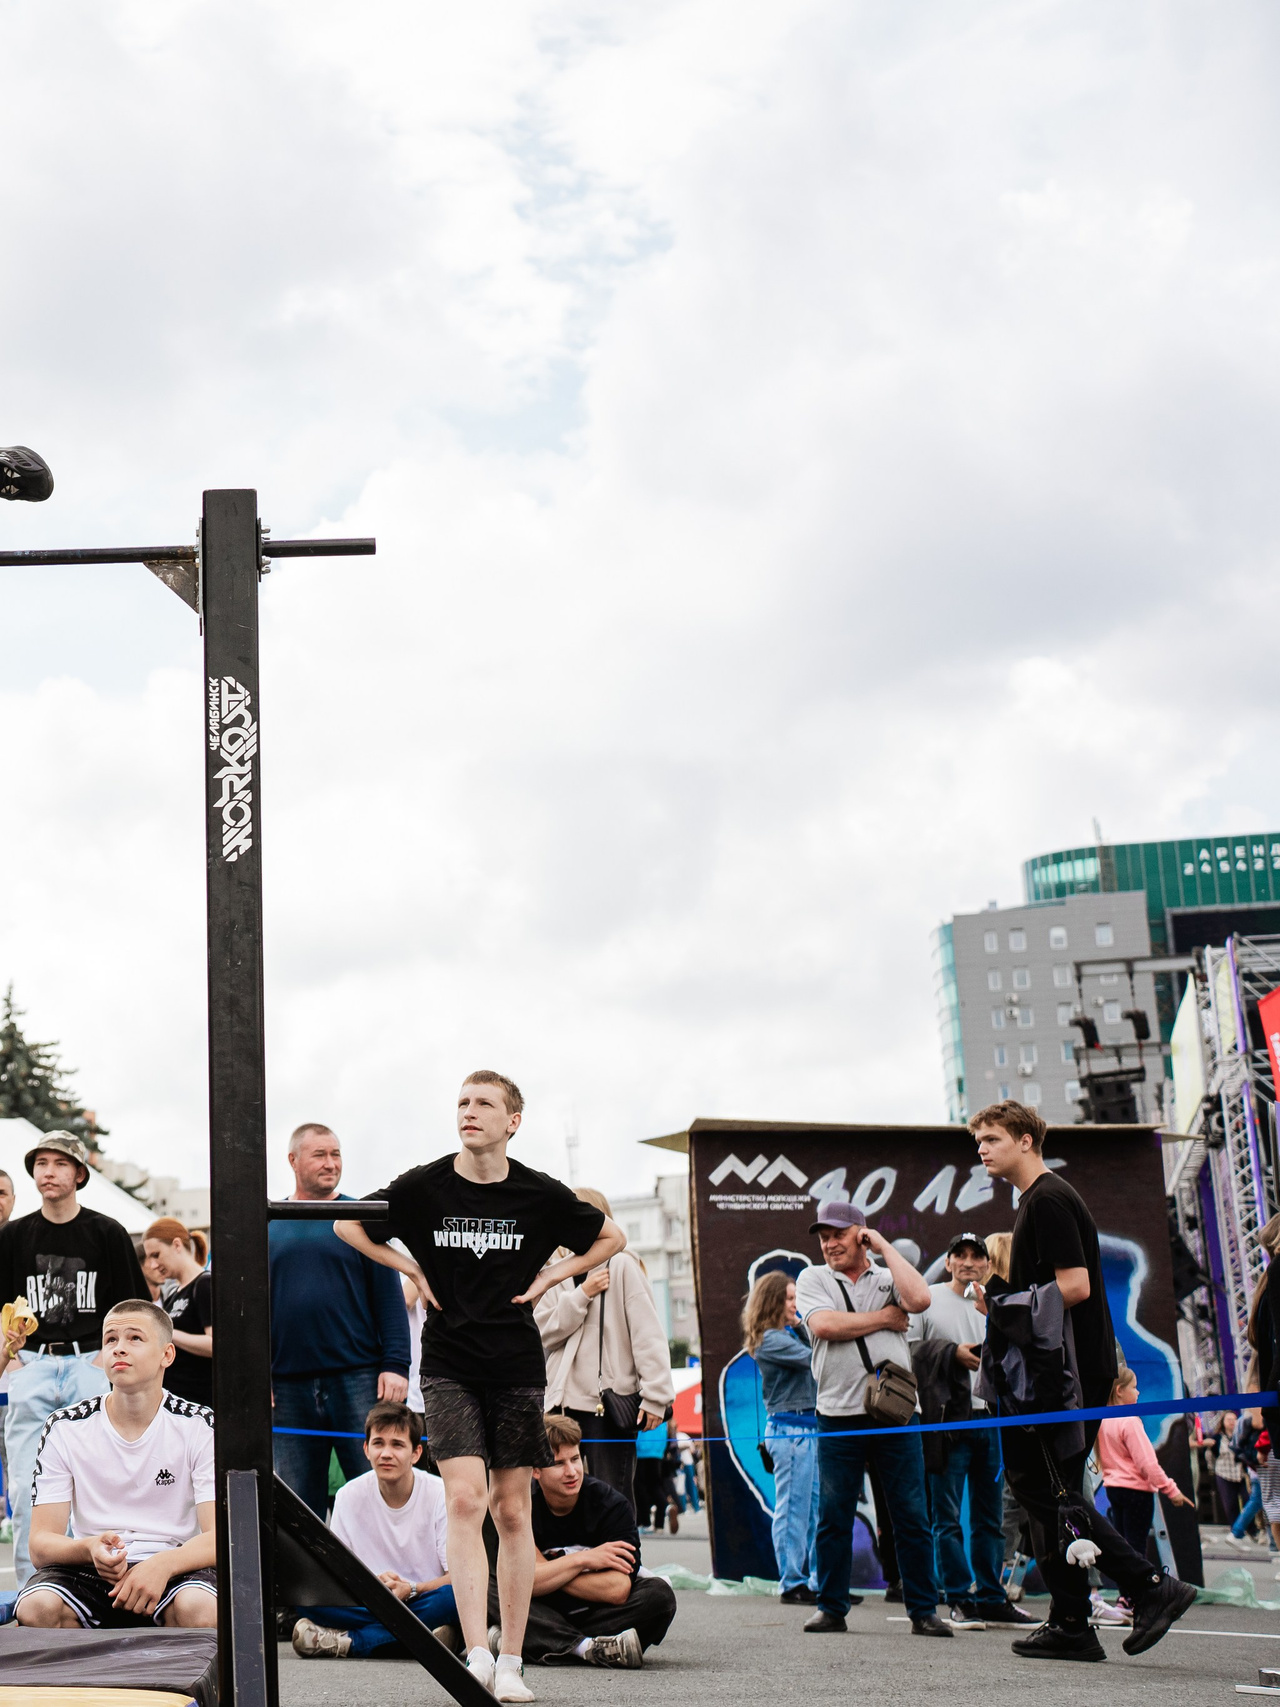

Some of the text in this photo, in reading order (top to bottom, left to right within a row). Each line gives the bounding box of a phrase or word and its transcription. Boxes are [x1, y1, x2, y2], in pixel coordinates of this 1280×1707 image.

[208, 676, 221, 751] ЧЕЛЯБИНСК
[212, 676, 258, 862] WORKOUT
[443, 1217, 517, 1234] STREET
[433, 1231, 525, 1250] WORKOUT
[155, 1478, 176, 1486] Kappa
